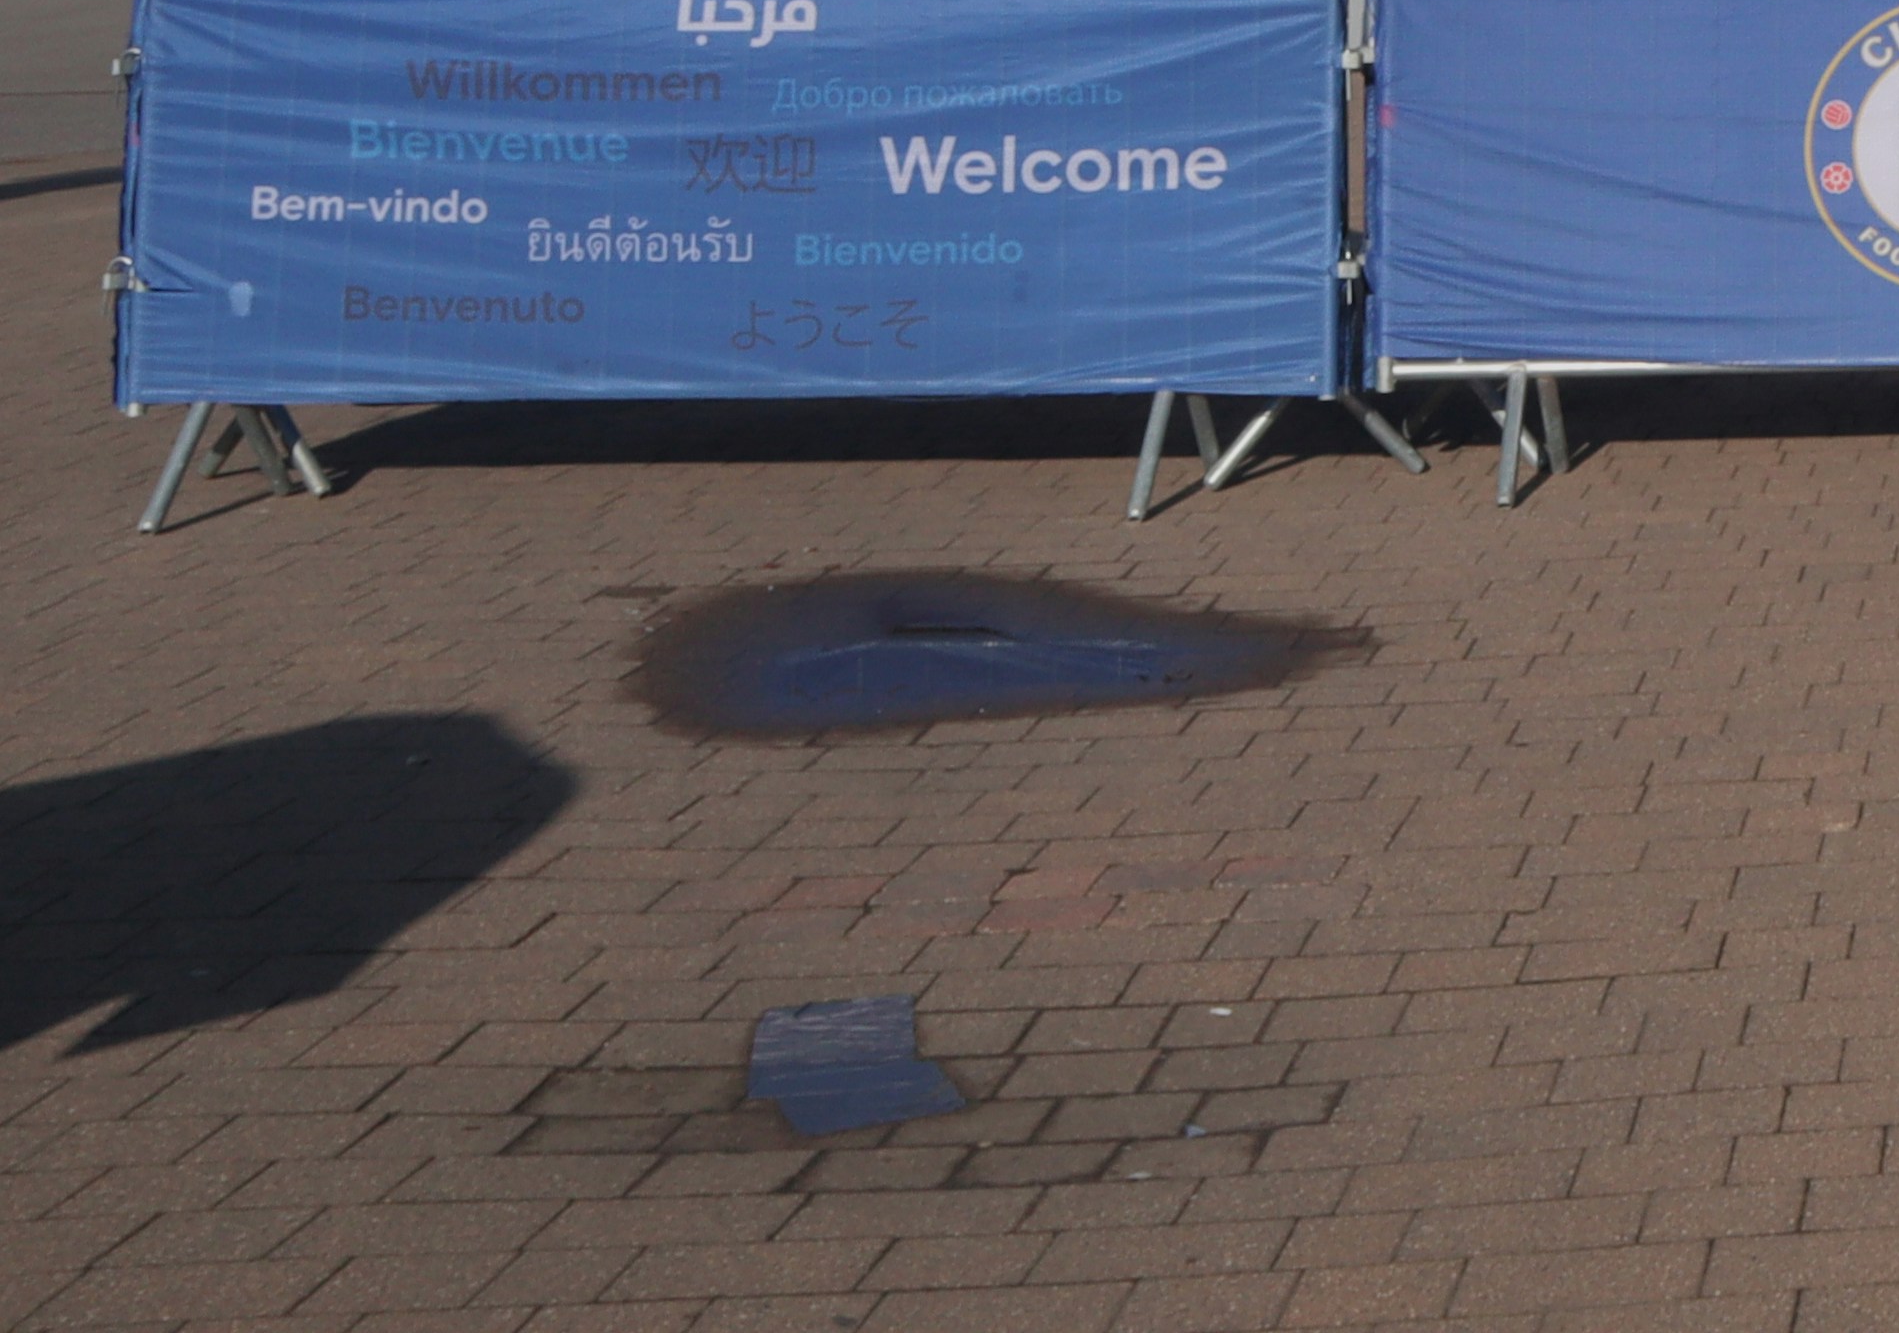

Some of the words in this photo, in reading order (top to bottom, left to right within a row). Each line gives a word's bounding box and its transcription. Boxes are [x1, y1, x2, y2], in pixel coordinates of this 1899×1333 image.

[405, 58, 722, 102] Willkommen
[771, 77, 893, 115] Добро
[903, 79, 1124, 110] пожаловать
[349, 118, 630, 163] Bienvenue
[684, 133, 816, 194] 欢迎
[880, 134, 1229, 195] Welcome
[252, 185, 489, 224] Bem-vindo
[527, 214, 753, 263] ยินดีต้อนรับ
[795, 233, 1024, 267] Bienvenido
[343, 284, 586, 326] Benvenuto
[730, 298, 930, 350] ようこそ
